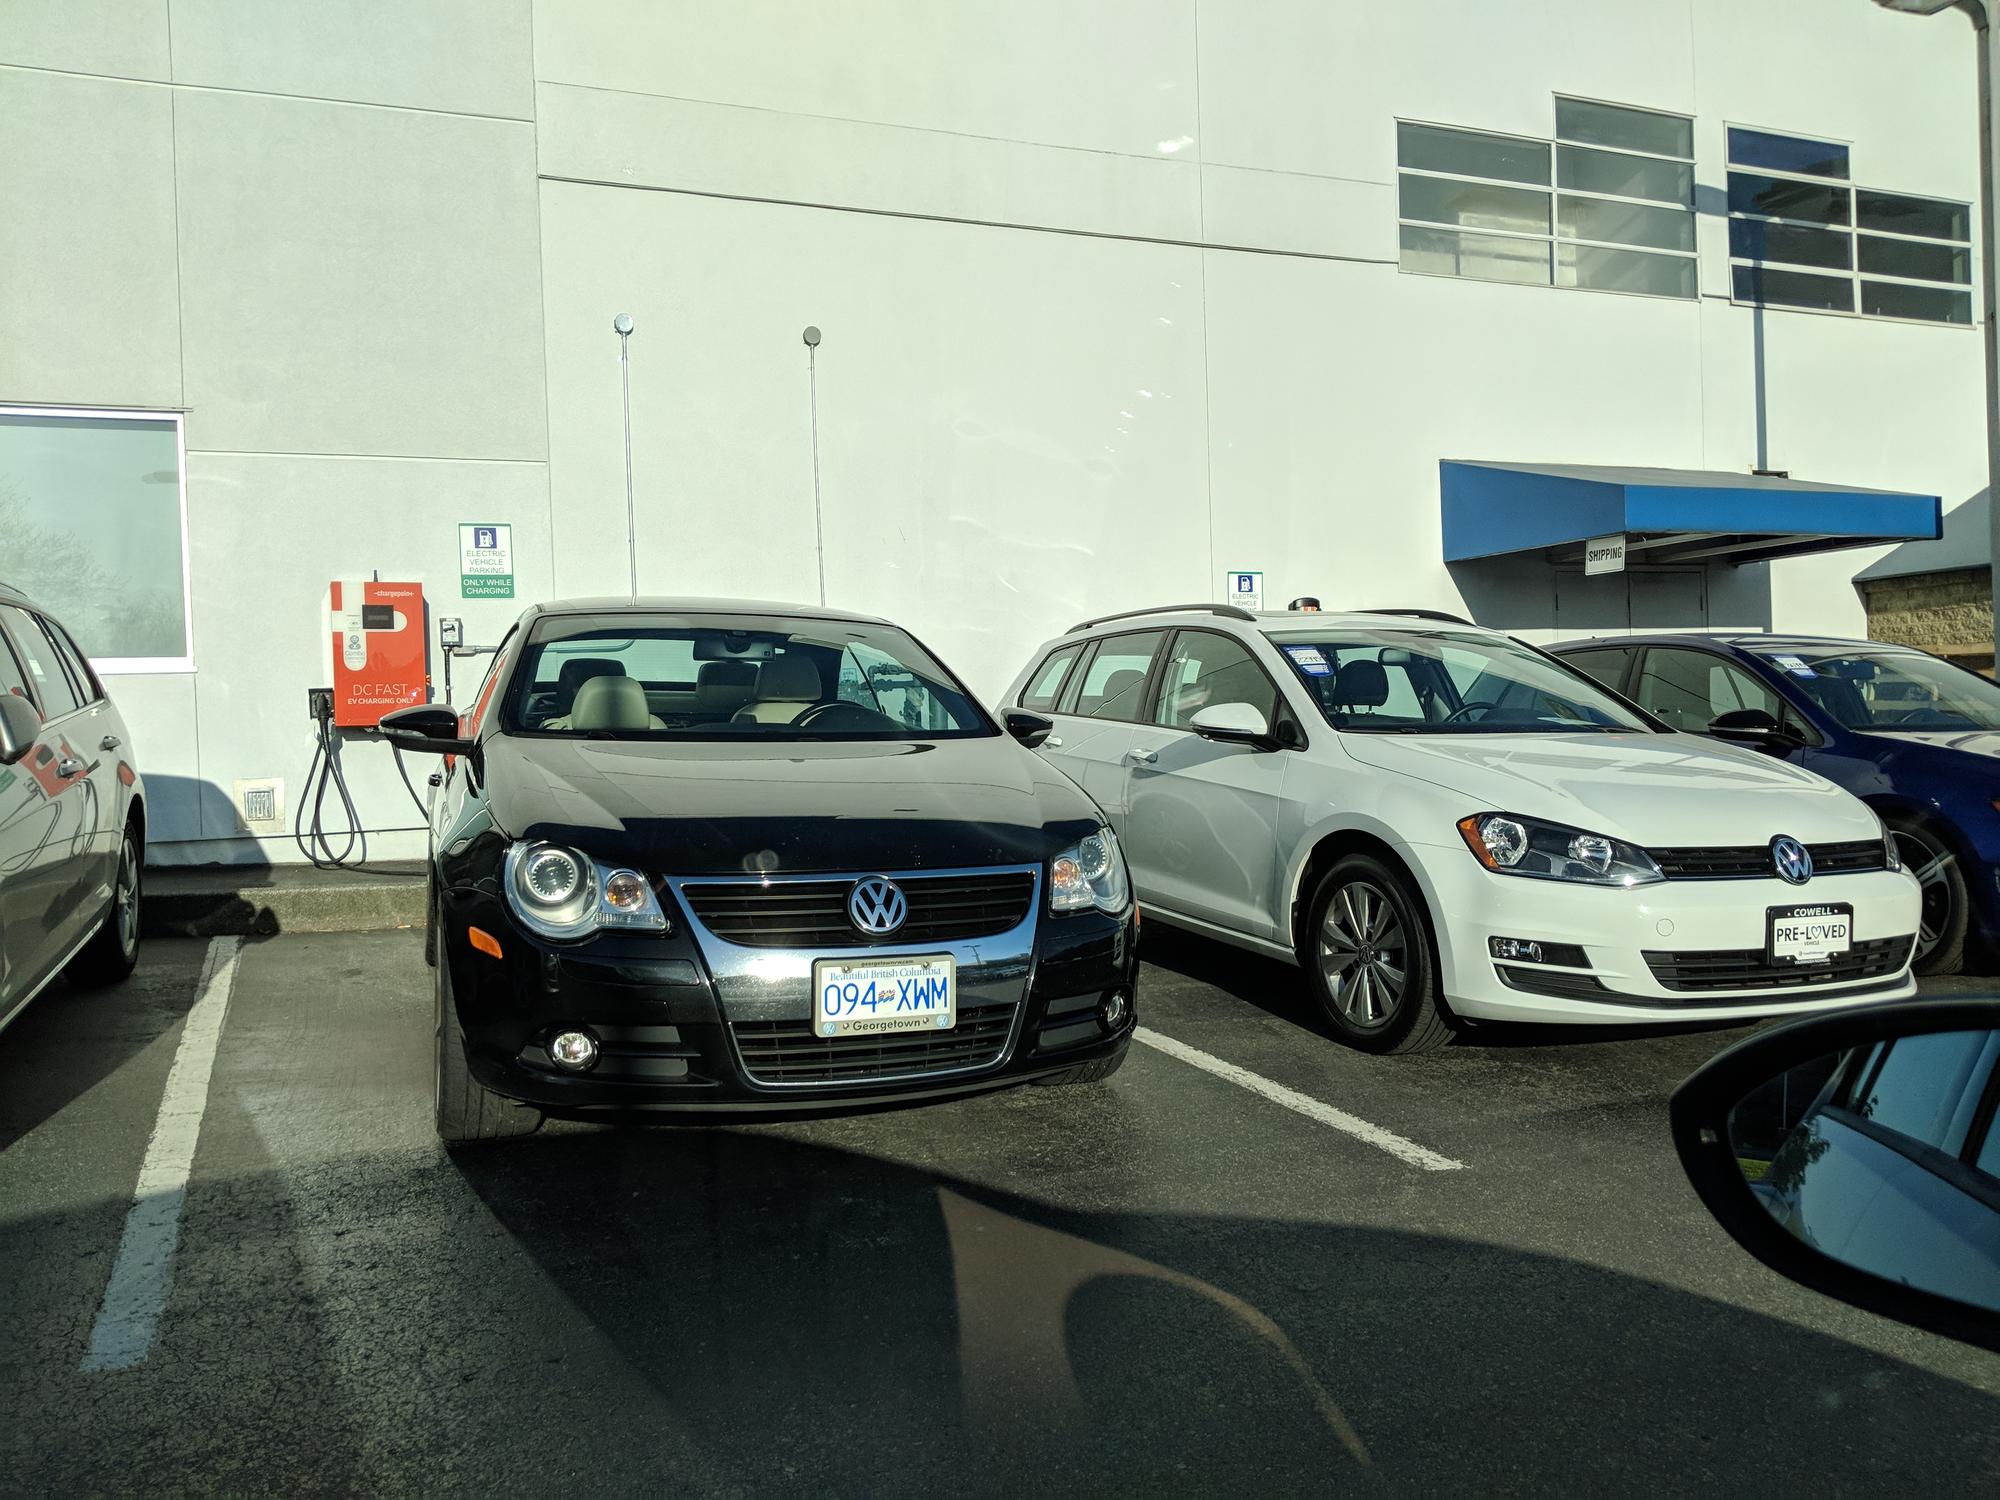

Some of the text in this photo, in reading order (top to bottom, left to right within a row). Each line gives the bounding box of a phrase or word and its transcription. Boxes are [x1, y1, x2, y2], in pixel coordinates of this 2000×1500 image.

[1588, 546, 1623, 562] SHIPPING
[466, 587, 510, 595] CHARGING
[353, 683, 408, 696] DC FAST
[358, 697, 395, 705] CHARGING
[850, 878, 907, 932] VW
[1793, 906, 1832, 917] COWELL
[830, 966, 941, 981] Beautiful British Columbia
[824, 976, 948, 1016] 094 XWM
[852, 1018, 921, 1032] Georgetown
